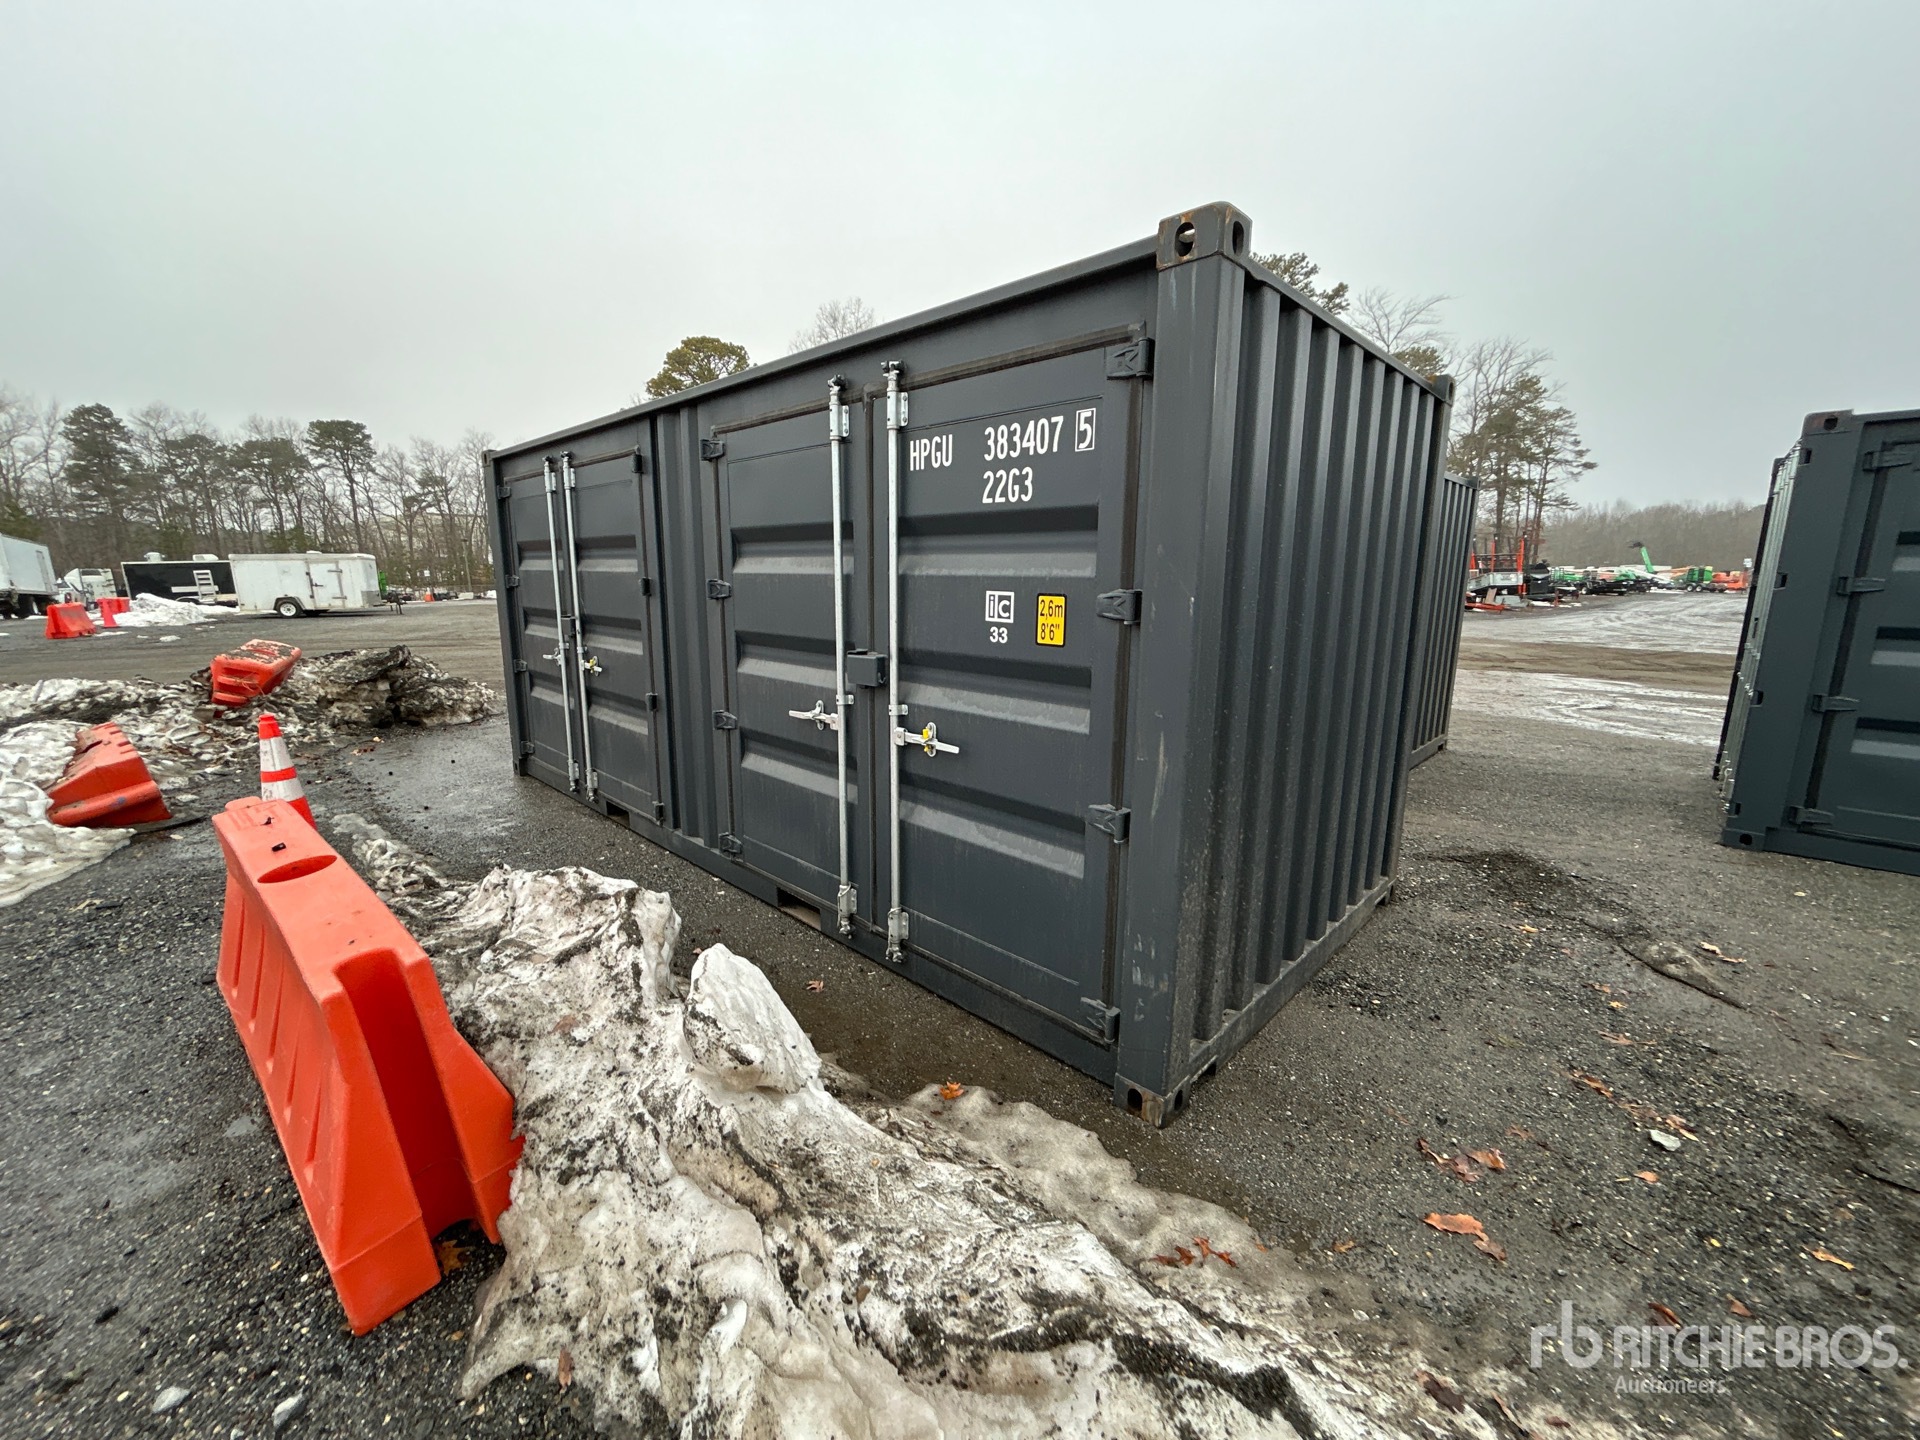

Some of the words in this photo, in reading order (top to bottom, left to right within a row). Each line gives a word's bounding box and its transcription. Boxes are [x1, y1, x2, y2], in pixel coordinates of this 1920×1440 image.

[909, 434, 953, 471] HPGU
[984, 415, 1064, 461] 383407
[1078, 411, 1093, 449] 5
[982, 466, 1033, 504] 22G3
[1039, 599, 1063, 621] 2,6m
[989, 627, 1008, 643] 33
